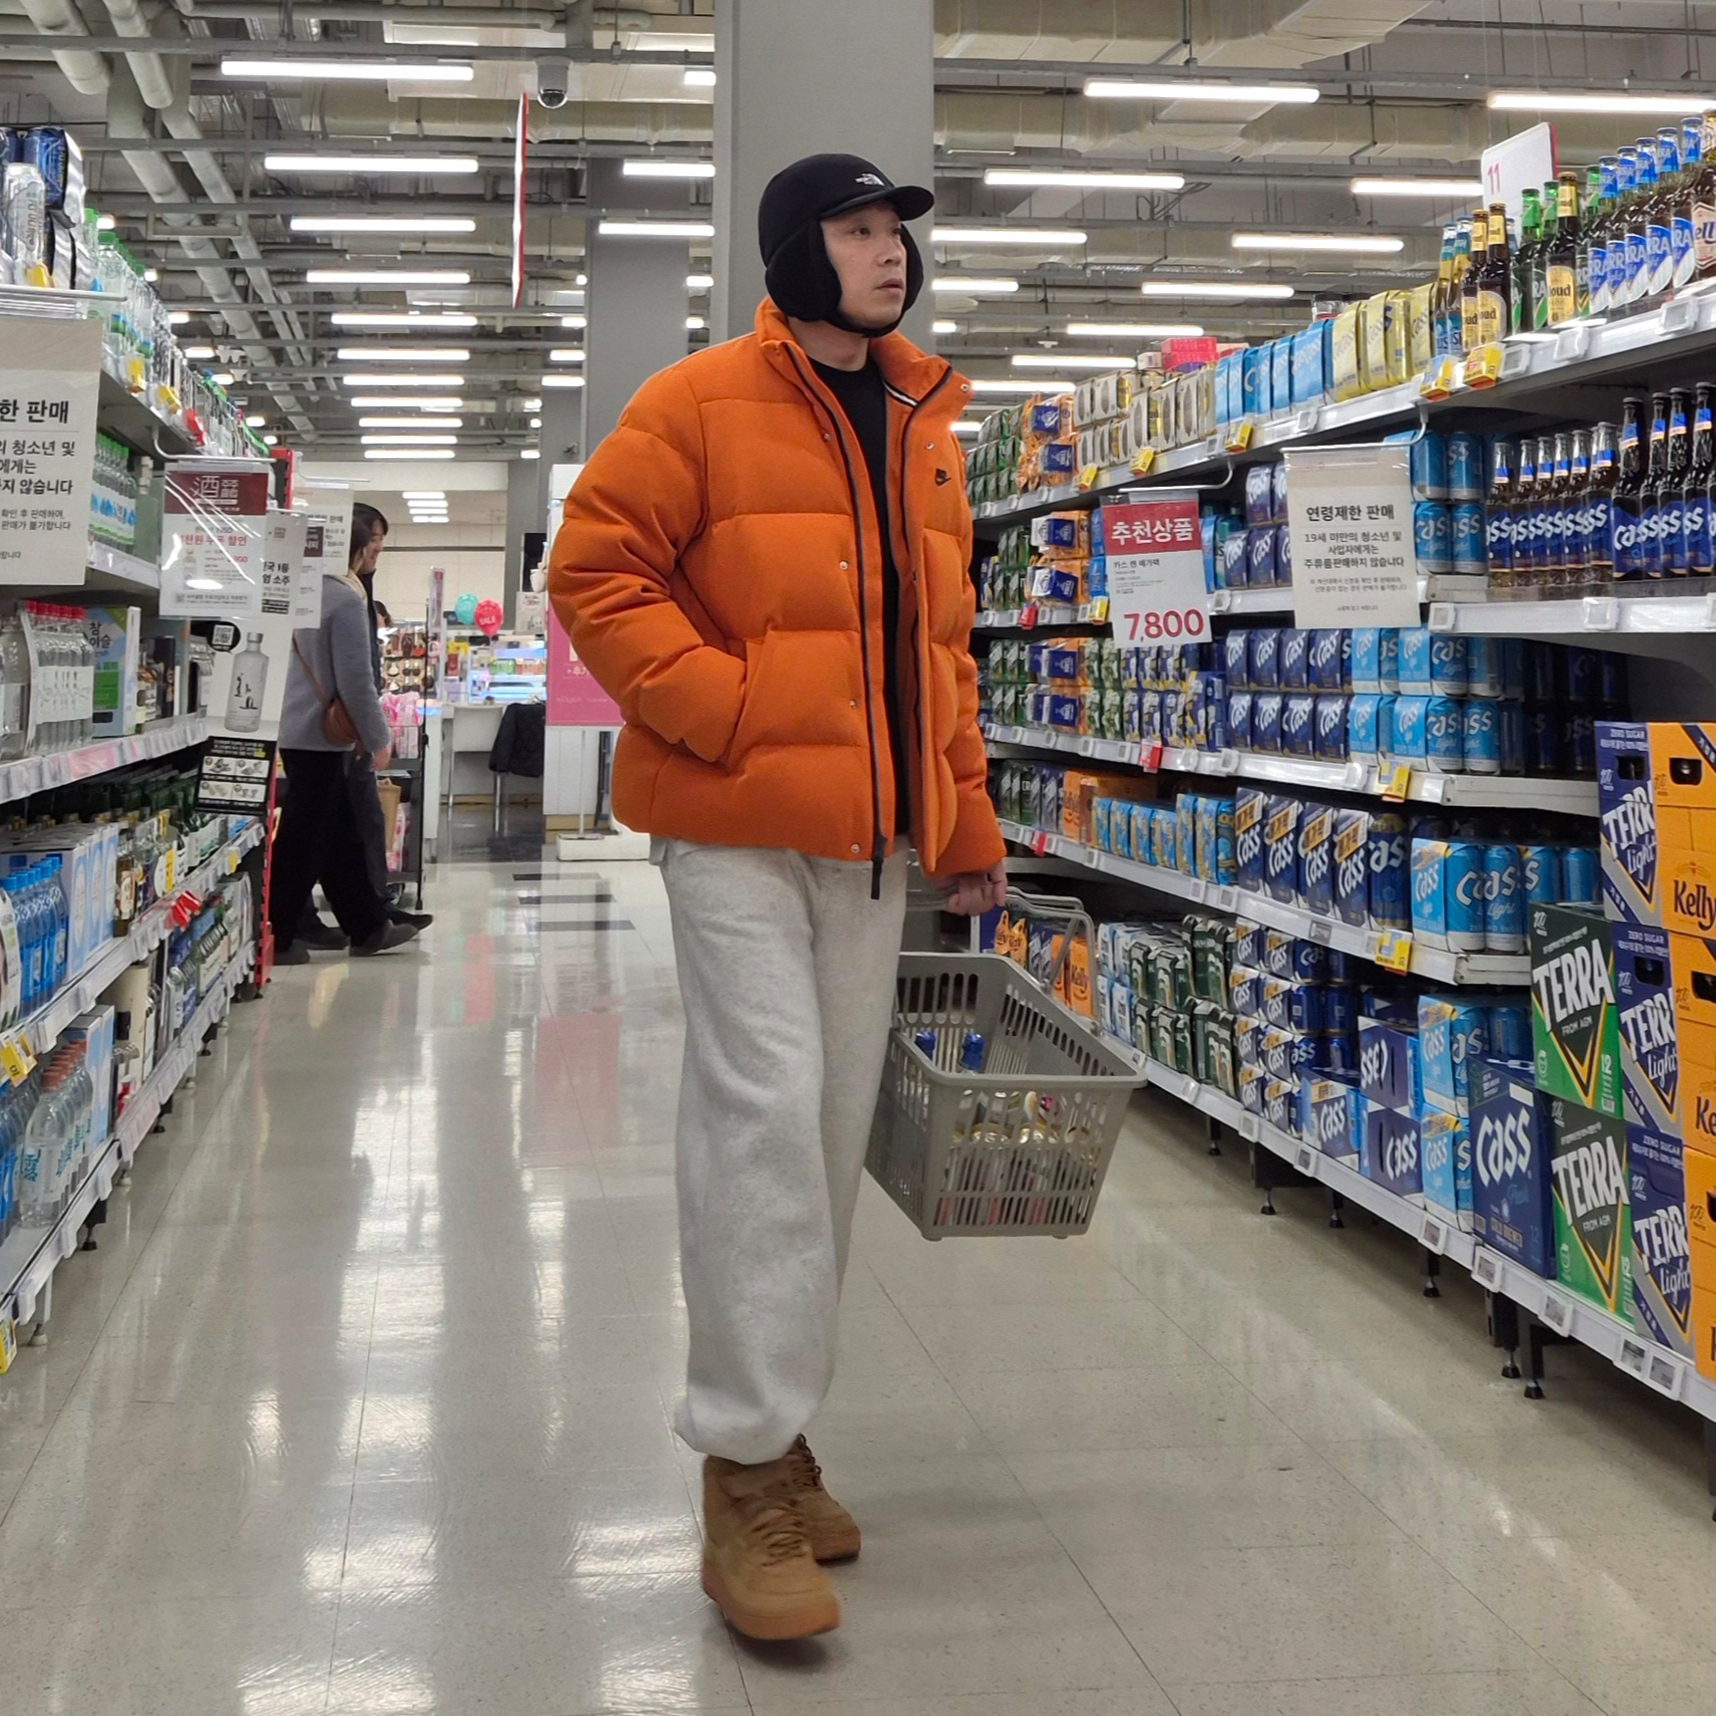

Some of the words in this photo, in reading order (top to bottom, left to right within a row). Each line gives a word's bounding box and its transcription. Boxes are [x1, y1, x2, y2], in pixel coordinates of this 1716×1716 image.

[1487, 163, 1501, 195] 11
[26, 400, 69, 423] 판매
[12, 439, 56, 456] 청소년
[61, 440, 75, 457] 및
[0, 458, 37, 474] 에게는
[0, 478, 15, 495] 지
[20, 478, 73, 495] 않습니다
[1306, 505, 1362, 522] 연령제한
[1366, 504, 1395, 520] 판매
[228, 535, 247, 547] 할인
[1111, 518, 1194, 545] 추천상품
[1305, 532, 1327, 543] 19세
[1329, 532, 1358, 542] 미만의
[1361, 531, 1389, 541] 청소년
[1370, 557, 1405, 567] 않습니다
[273, 574, 290, 585] 소주
[1124, 608, 1205, 642] 7,800
[90, 636, 113, 649] 이슬
[1602, 779, 1656, 861] TERR
[1269, 832, 1295, 878] Cass
[1306, 840, 1329, 888] Cass
[1338, 848, 1365, 899] Cass
[1414, 862, 1440, 903] Cass
[1674, 879, 1716, 931] Kelly
[1644, 933, 1665, 945] SUGAR
[1532, 938, 1616, 1035] TERRA
[1561, 1020, 1579, 1037] FROM
[1619, 987, 1677, 1064] TERR
[1321, 1098, 1346, 1142] Cass
[1475, 1106, 1532, 1188] Cass
[1551, 1135, 1630, 1227] TERRA
[1633, 1201, 1690, 1275] TERR
